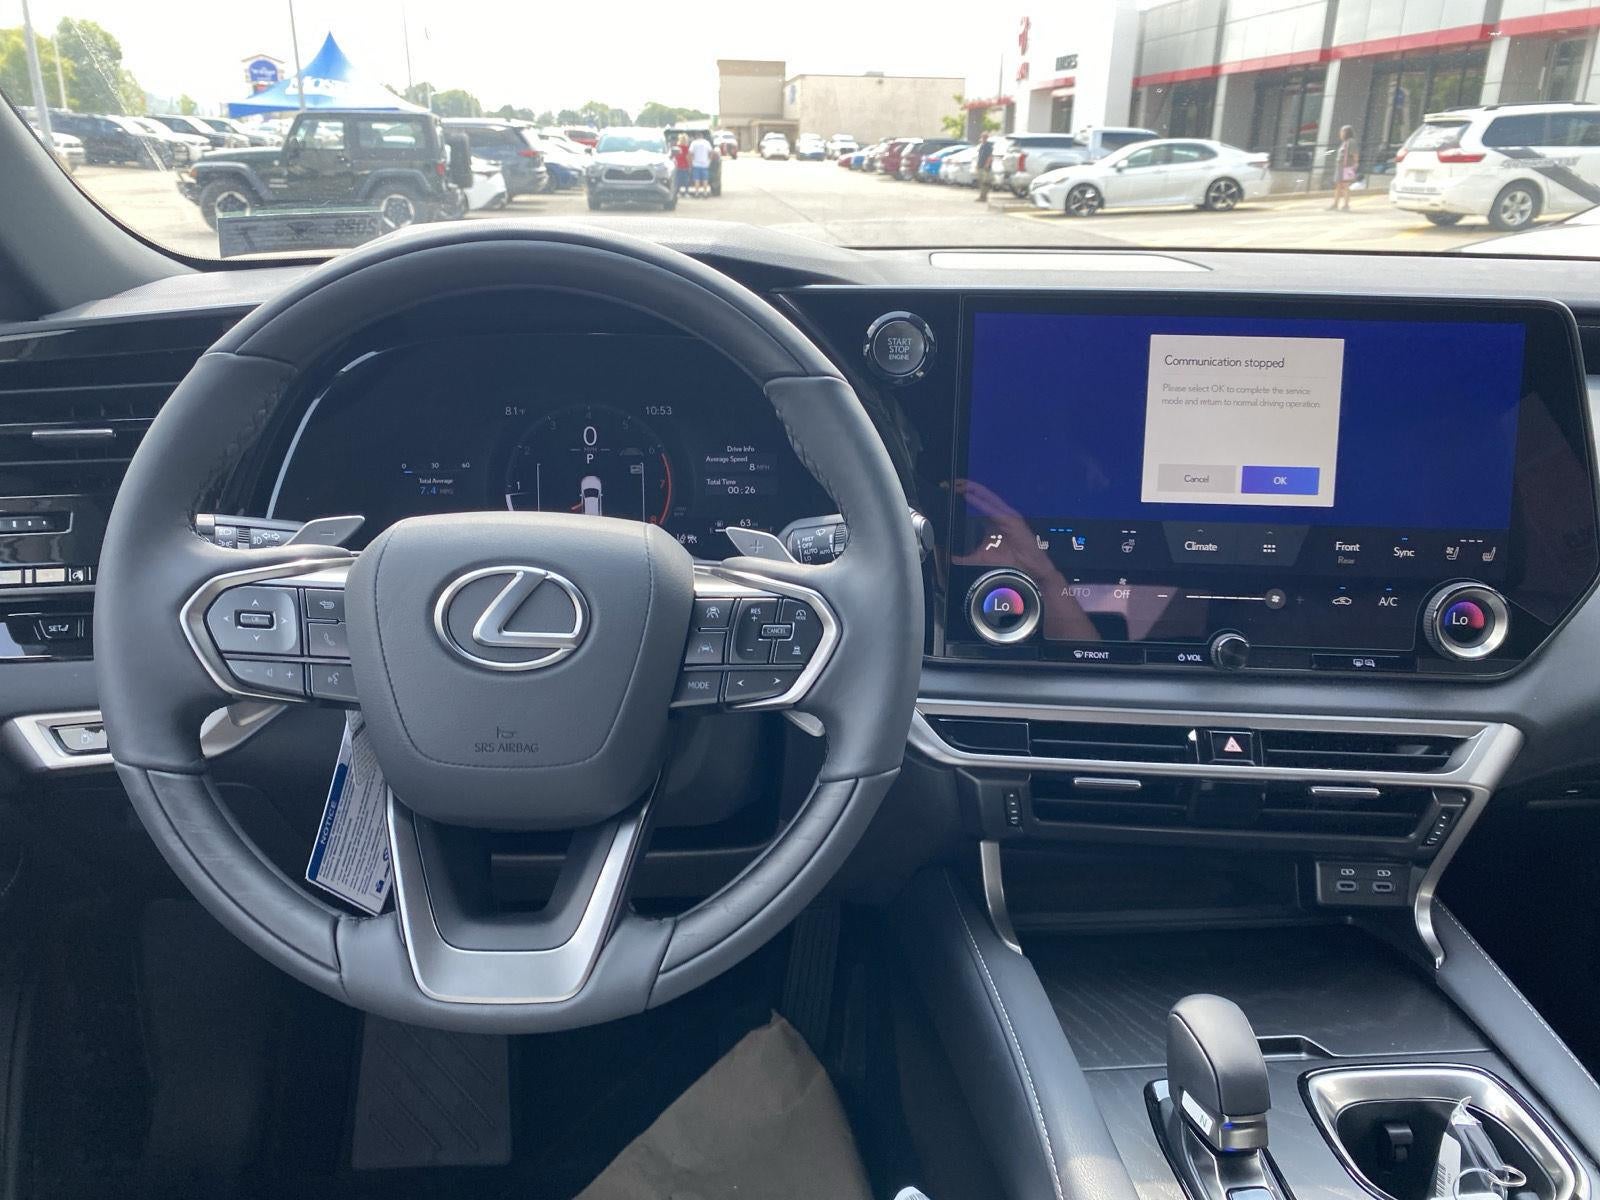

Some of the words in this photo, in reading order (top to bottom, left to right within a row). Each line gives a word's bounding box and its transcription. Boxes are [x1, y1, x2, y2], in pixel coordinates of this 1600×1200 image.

[888, 338, 912, 346] START
[1164, 354, 1242, 367] Communication
[1244, 357, 1285, 370] stopped
[1162, 383, 1187, 393] Please
[1188, 384, 1209, 393] select
[1210, 384, 1226, 393] OK
[1227, 386, 1235, 394] to
[1235, 385, 1271, 396] complete
[1271, 386, 1284, 395] the
[1285, 387, 1311, 396] service
[1162, 396, 1183, 405] mode
[1184, 397, 1199, 406] and
[1200, 398, 1222, 407] return
[1232, 399, 1260, 407] normal
[1260, 399, 1284, 410] driving
[645, 406, 672, 416] 10:53
[583, 425, 597, 446] 0
[727, 445, 742, 453] Drive
[744, 445, 755, 453] Info
[586, 453, 594, 464] P
[705, 456, 729, 464] Average
[730, 455, 748, 464] Speed
[749, 463, 756, 471] 8
[706, 478, 721, 486] Total
[722, 478, 737, 486] Time
[1184, 474, 1210, 483] Cancel
[1273, 476, 1287, 485] OK
[420, 486, 437, 495] 7.4
[740, 518, 752, 527] 63
[1184, 541, 1218, 551] Climate
[1335, 541, 1360, 552] Front
[1393, 546, 1415, 560] Sync
[1337, 556, 1355, 565] Rear
[1061, 587, 1091, 598] AUTO
[1113, 588, 1130, 600] Off
[994, 598, 1010, 612] Lo
[1378, 596, 1398, 607] A/C
[750, 607, 761, 615] RES
[1452, 612, 1468, 626] Lo
[48, 624, 62, 632] SET
[1084, 651, 1110, 660] FRONT
[1186, 654, 1203, 662] VOL
[687, 681, 711, 690] MODE
[474, 742, 495, 753] SRS
[497, 742, 540, 753] AIRBAG
[320, 800, 338, 846] NOTICE
